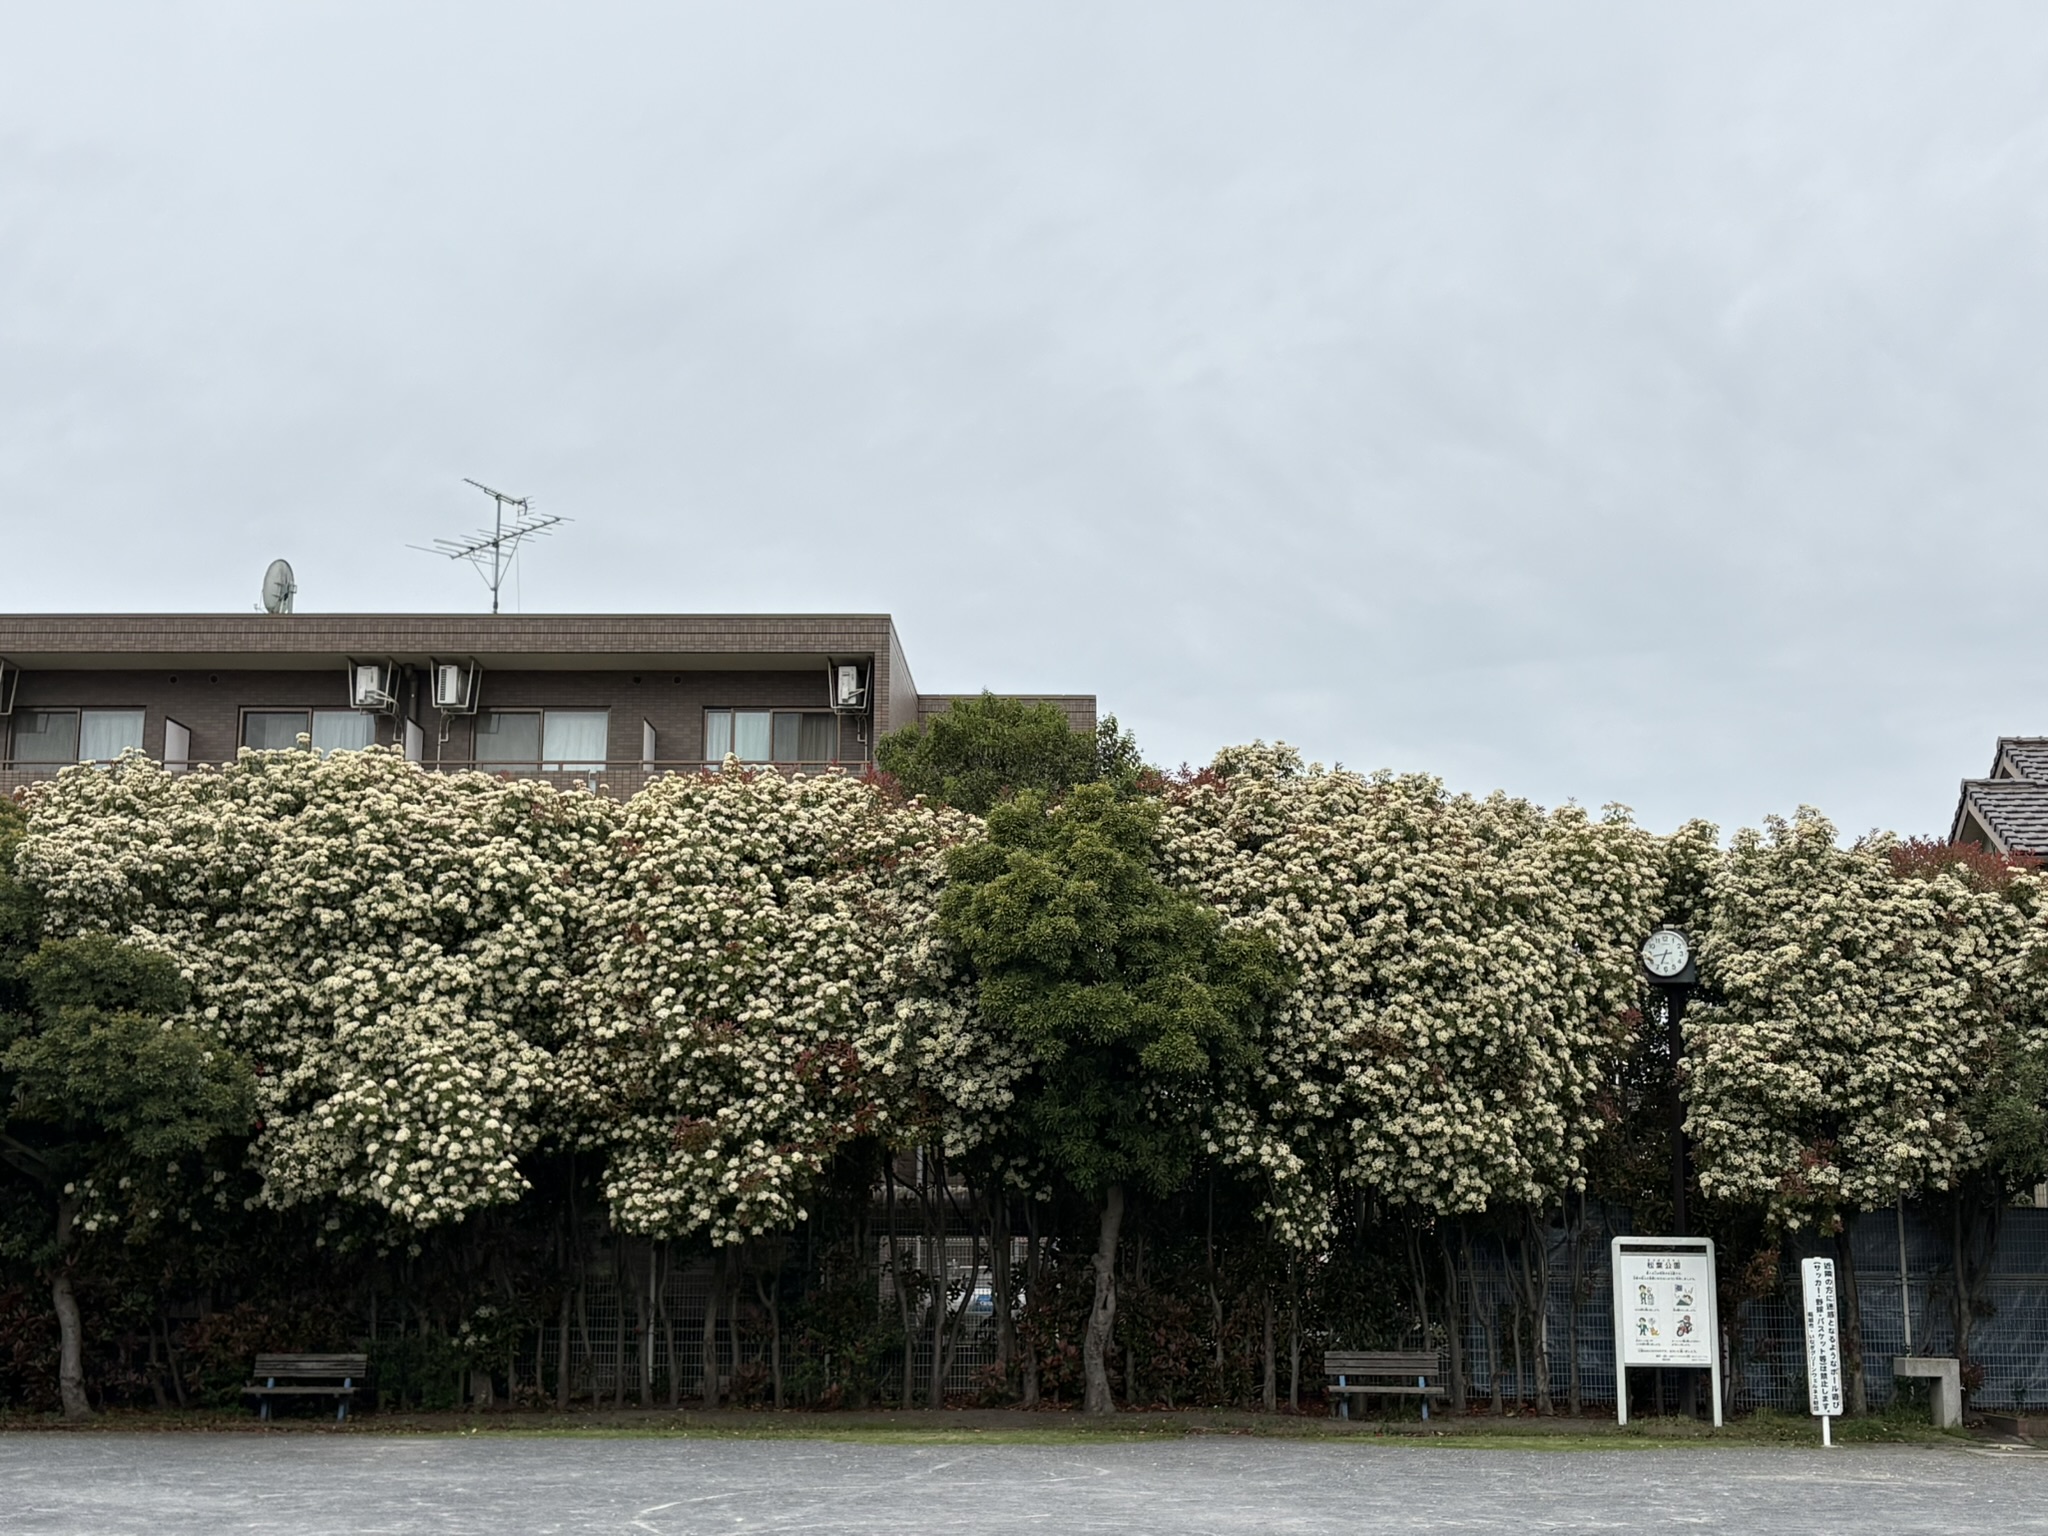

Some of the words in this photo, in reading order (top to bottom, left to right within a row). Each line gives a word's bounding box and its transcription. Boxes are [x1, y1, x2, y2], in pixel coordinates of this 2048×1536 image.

[1824, 1262, 1840, 1409] 近隣の方に迷惑となるようなボール遊び
